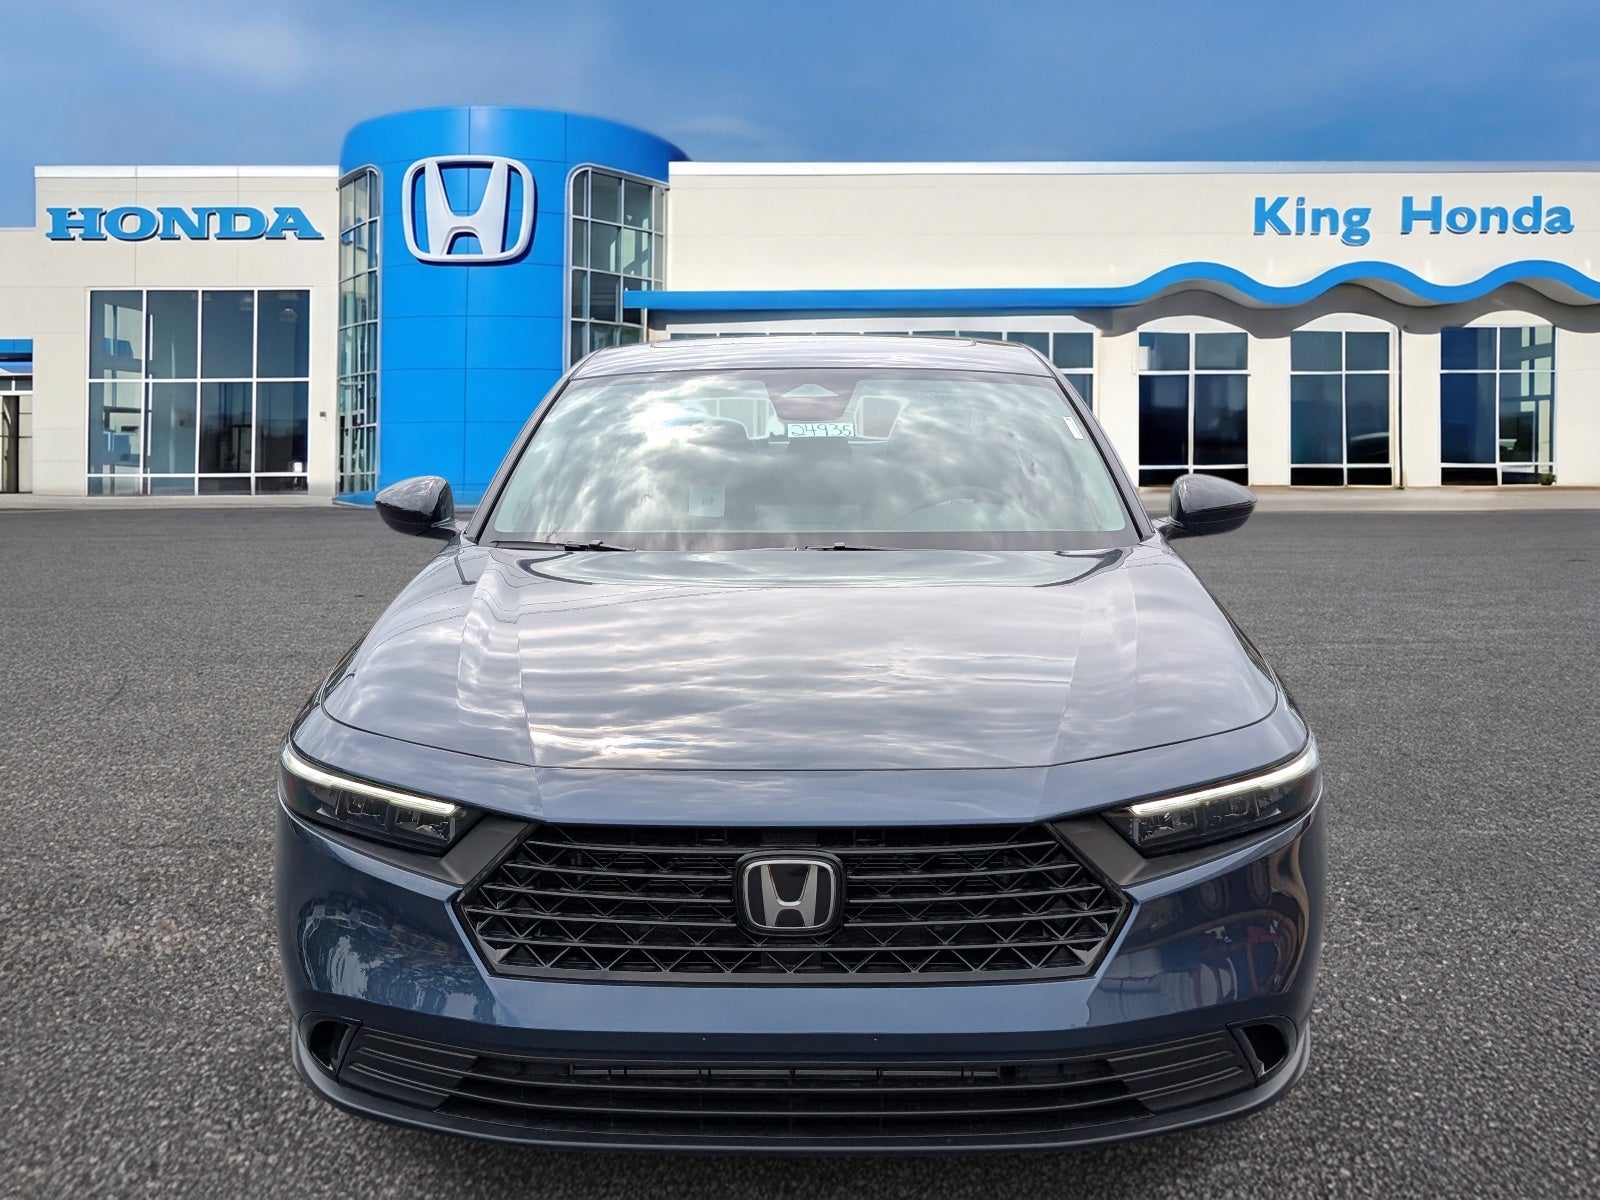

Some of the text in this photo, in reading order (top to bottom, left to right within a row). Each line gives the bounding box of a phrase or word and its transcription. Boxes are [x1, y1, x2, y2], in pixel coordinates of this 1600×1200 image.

[45, 206, 325, 242] HONDA
[1253, 195, 1575, 246] King Honda
[791, 423, 852, 437] 24935
